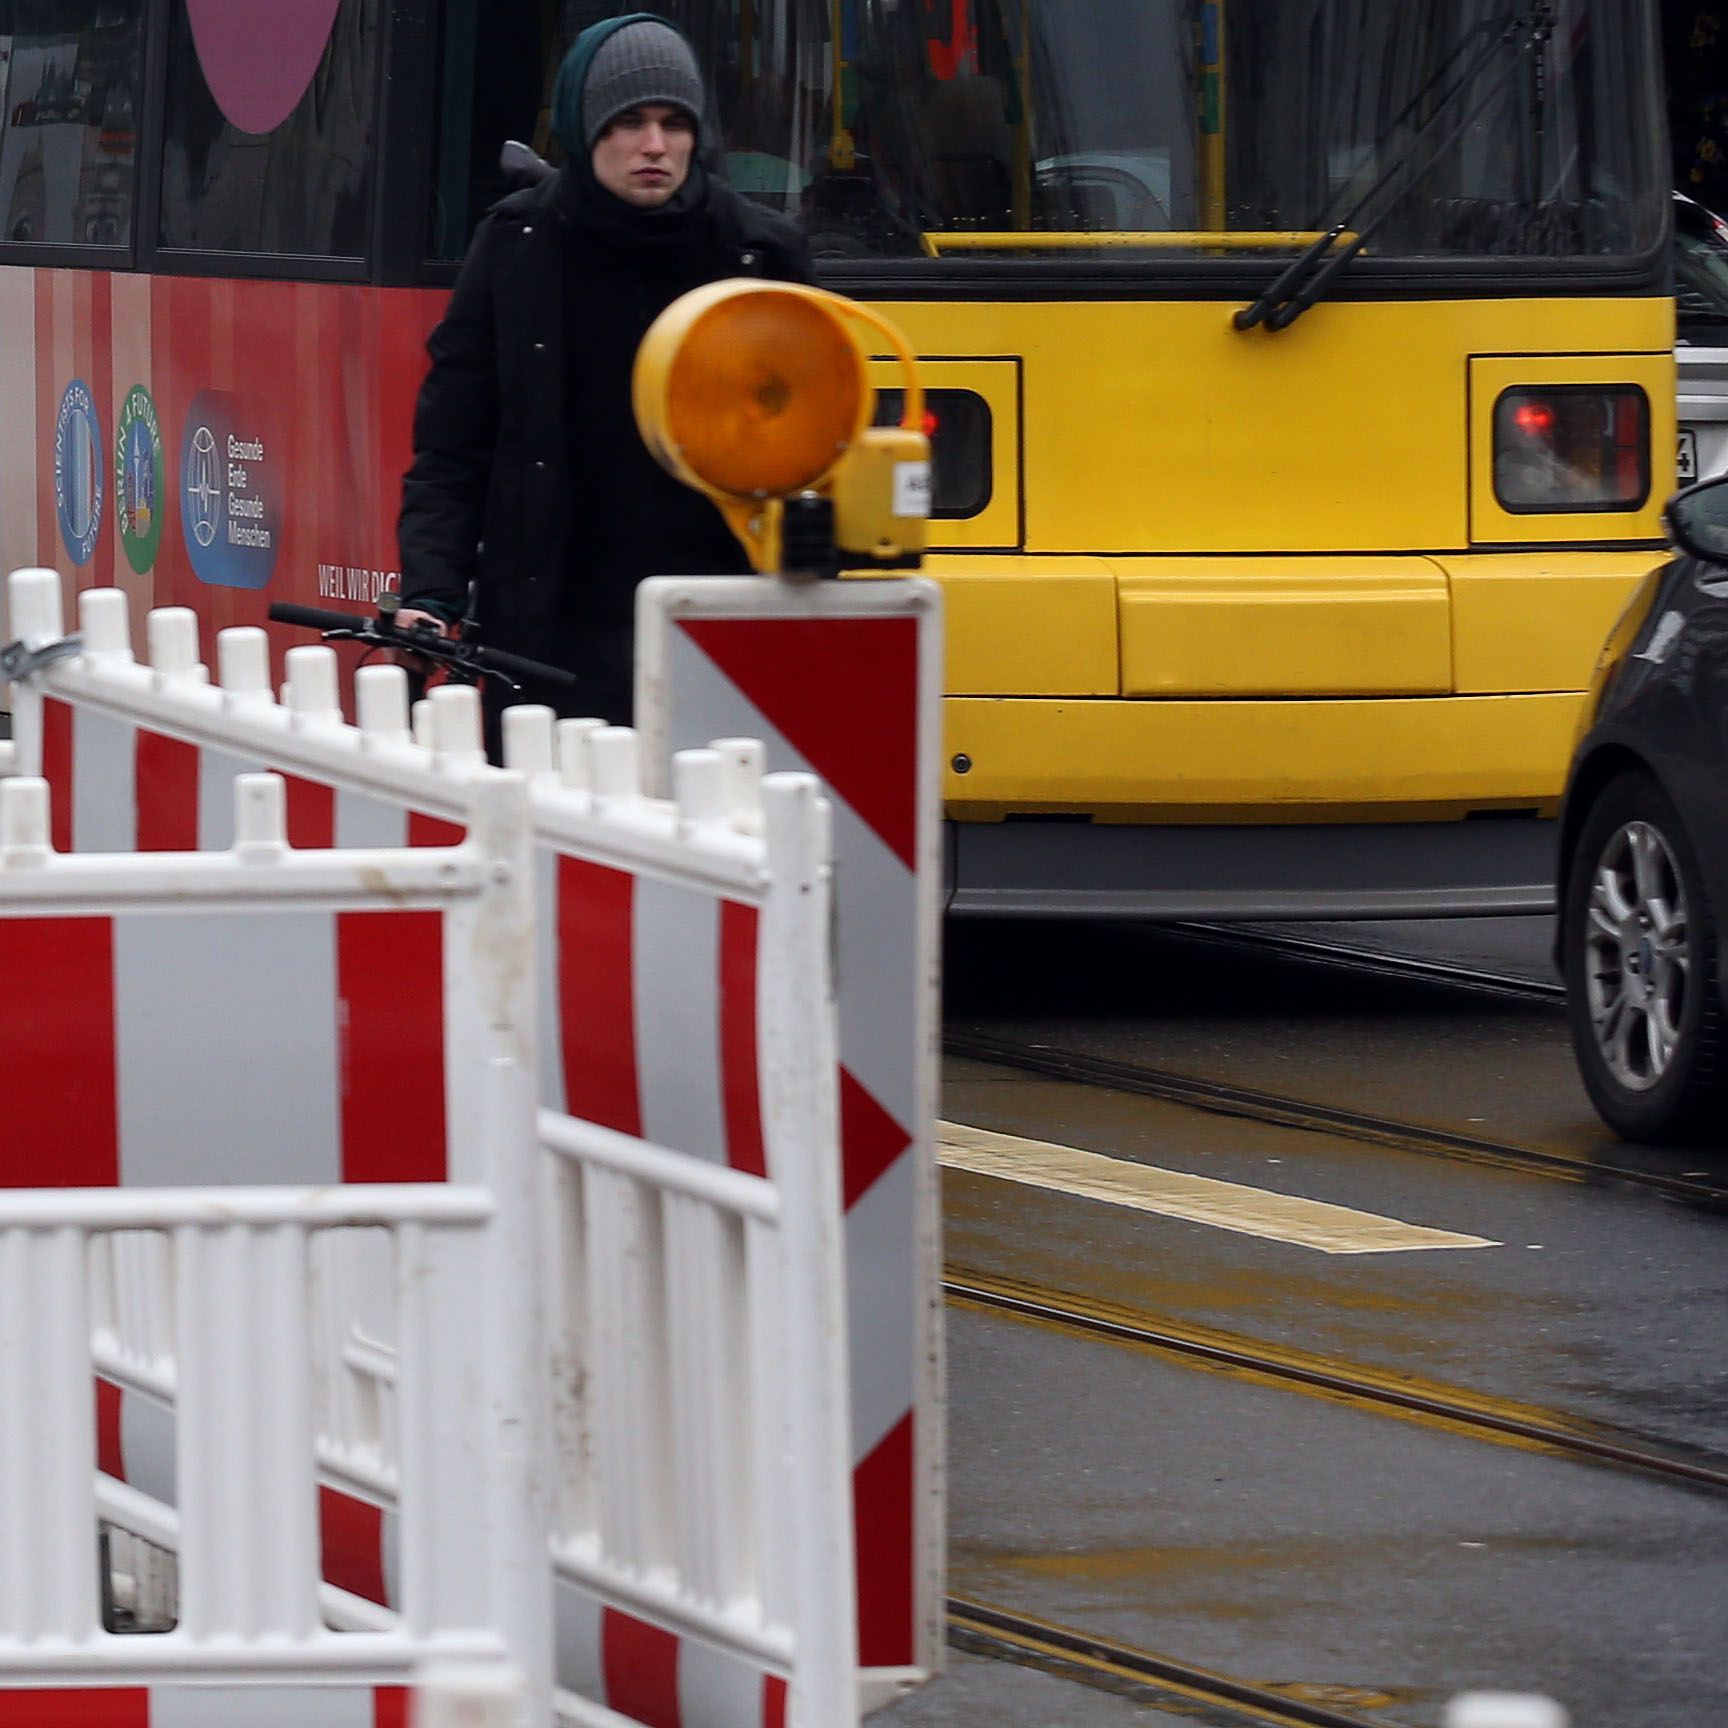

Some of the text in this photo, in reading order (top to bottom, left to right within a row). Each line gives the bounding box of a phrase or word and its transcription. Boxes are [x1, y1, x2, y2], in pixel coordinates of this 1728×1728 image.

[227, 434, 264, 462] Gesunde
[227, 463, 247, 488] Erde
[227, 491, 264, 519] Gesunde
[227, 520, 271, 549] Menschen
[318, 564, 401, 603] WEIL WIR DIC
